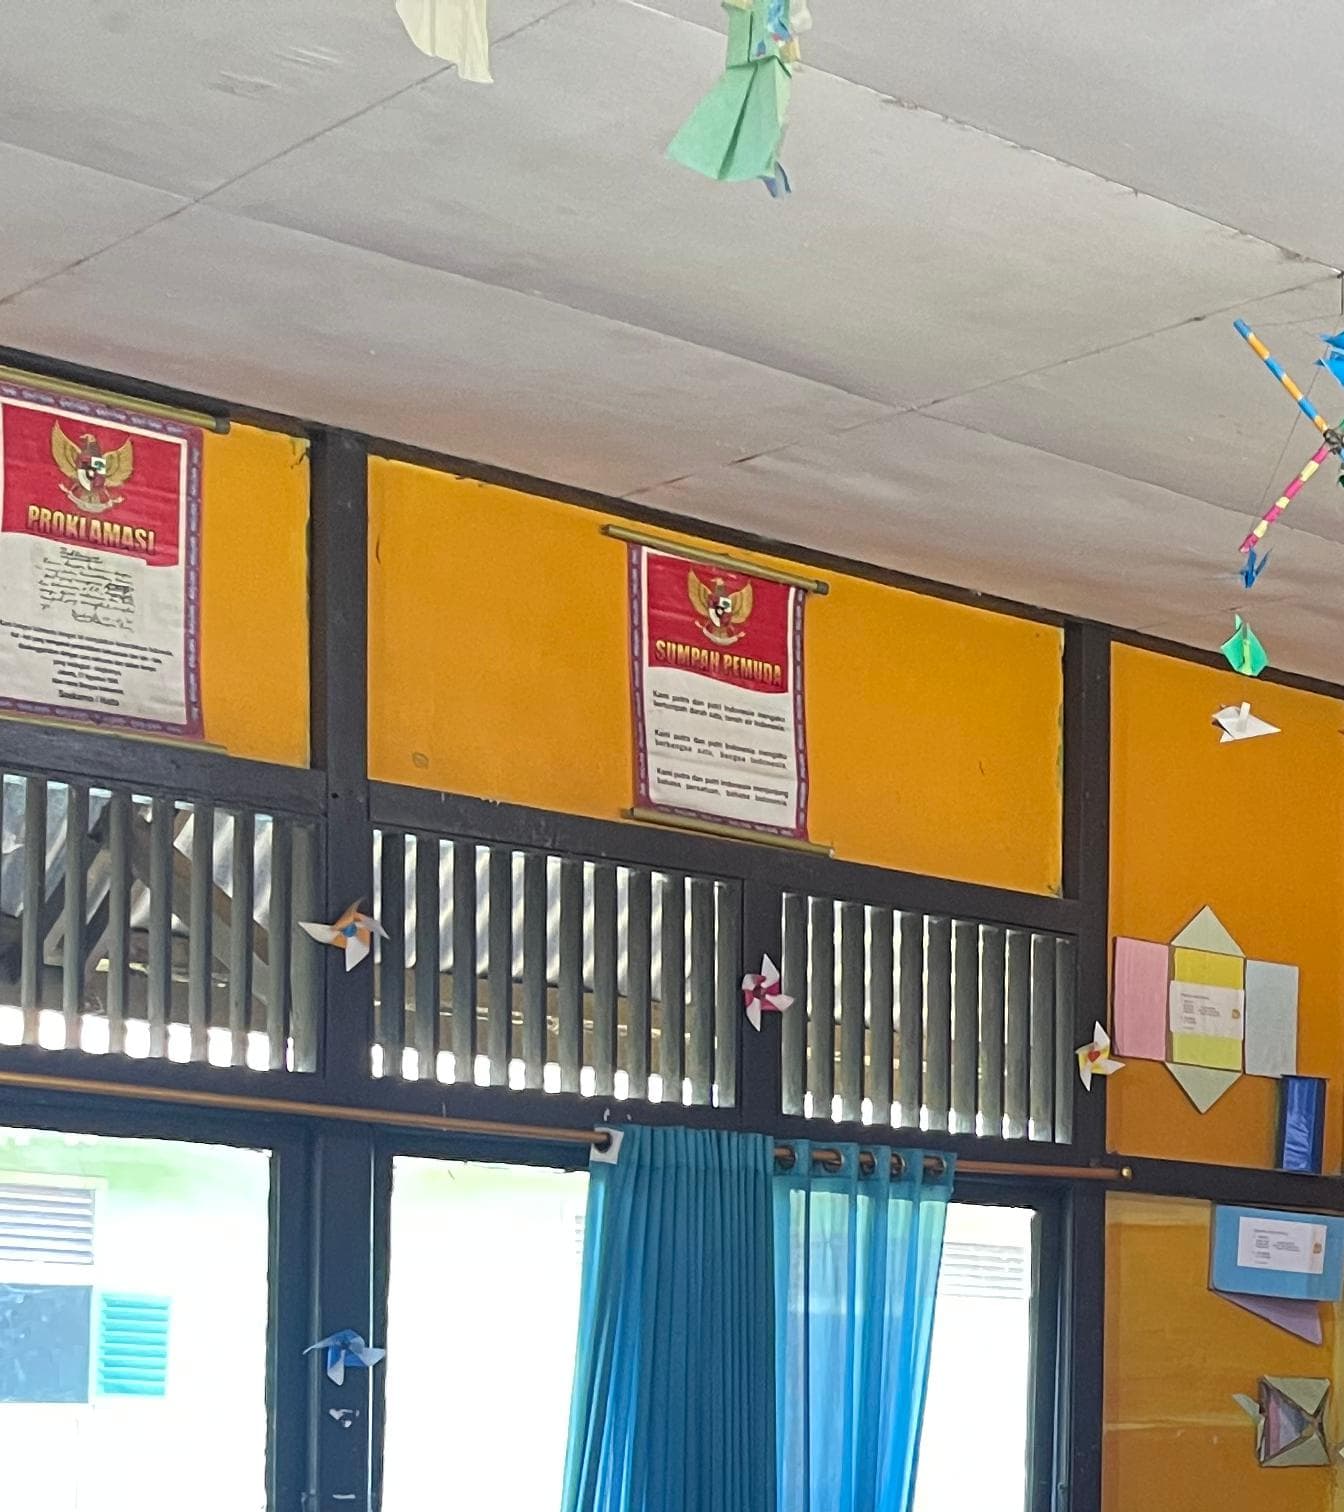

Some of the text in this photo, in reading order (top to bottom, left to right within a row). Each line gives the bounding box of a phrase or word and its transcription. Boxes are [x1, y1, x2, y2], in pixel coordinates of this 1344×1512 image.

[27, 504, 156, 555] PROKLAMASI
[655, 639, 783, 686] SUMPAH PEMUDA
